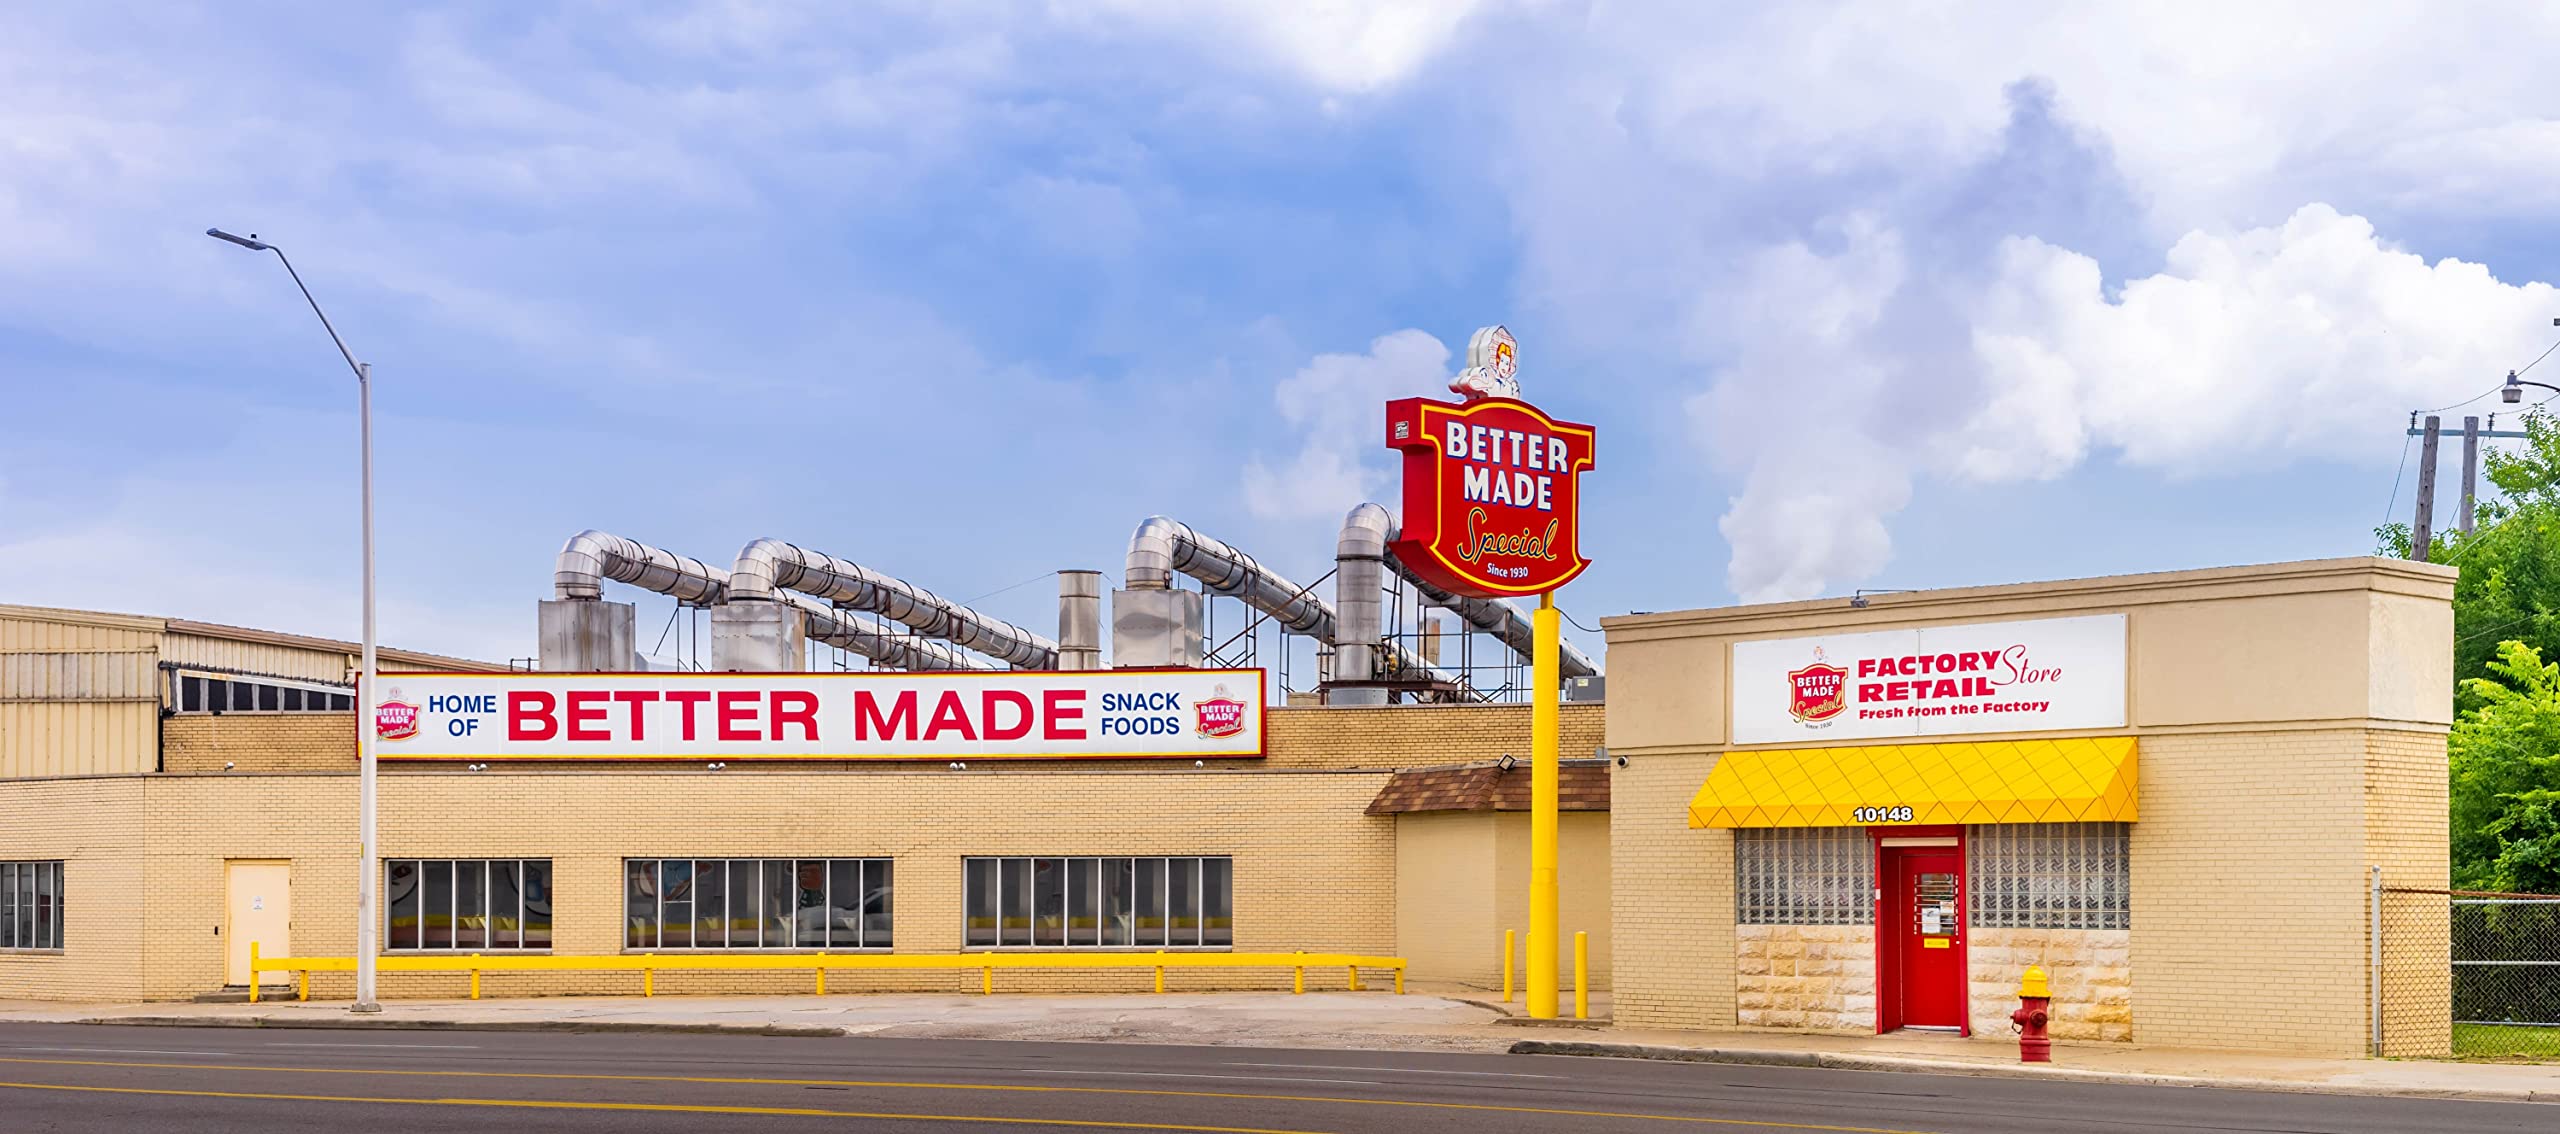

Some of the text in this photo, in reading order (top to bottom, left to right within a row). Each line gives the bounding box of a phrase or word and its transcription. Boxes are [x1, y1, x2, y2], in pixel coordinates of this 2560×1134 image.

[1446, 420, 1568, 474] BETTER
[1463, 464, 1552, 511] MADE
[1457, 506, 1558, 565] Special
[1487, 562, 1529, 578] Since 1930
[1858, 644, 2062, 686] FACTORY Store
[1797, 675, 1840, 687] BETTER
[1858, 677, 1995, 702] RETAIL
[1802, 686, 1834, 698] MADE
[429, 695, 497, 713] HOME
[1102, 692, 1180, 712] SNACK
[1200, 705, 1240, 713] BETTER
[1793, 690, 1842, 723] Special
[1859, 701, 2050, 719] Fresh from the Factory
[376, 708, 415, 716] BETTER
[380, 716, 409, 724] MADE
[508, 690, 1087, 741] BETTER MADE
[1206, 713, 1234, 721] MADE
[448, 719, 479, 736] OF
[1102, 716, 1180, 736] FOODS
[1853, 806, 1914, 822] 10148
